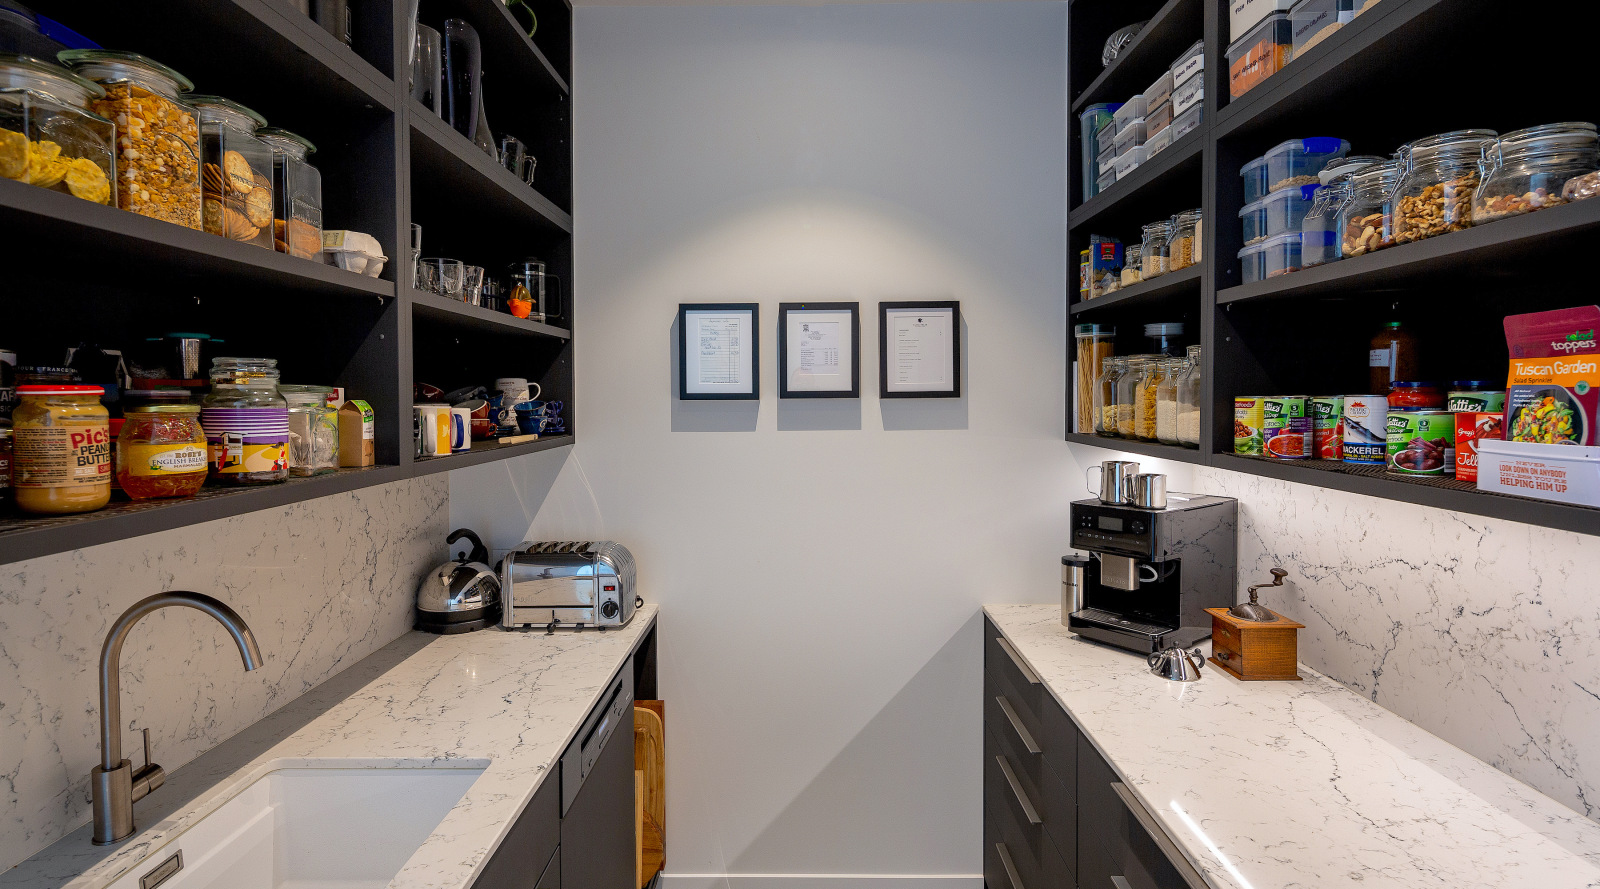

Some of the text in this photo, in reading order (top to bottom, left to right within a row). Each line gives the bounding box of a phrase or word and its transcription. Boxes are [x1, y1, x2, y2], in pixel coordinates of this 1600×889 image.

[1566, 329, 1594, 341] salad
[1551, 340, 1597, 353] toppers
[1515, 360, 1597, 376] Tuscan Garden
[70, 427, 109, 450] Pic's
[1458, 428, 1475, 438] Gregg's
[77, 454, 110, 467] BUTTE
[152, 458, 187, 466] ENGLISH
[1457, 452, 1478, 467] Jell
[1499, 464, 1567, 478] LOOK DOWN ON ANYBODY
[1500, 477, 1568, 493] HELPING HIM UP
